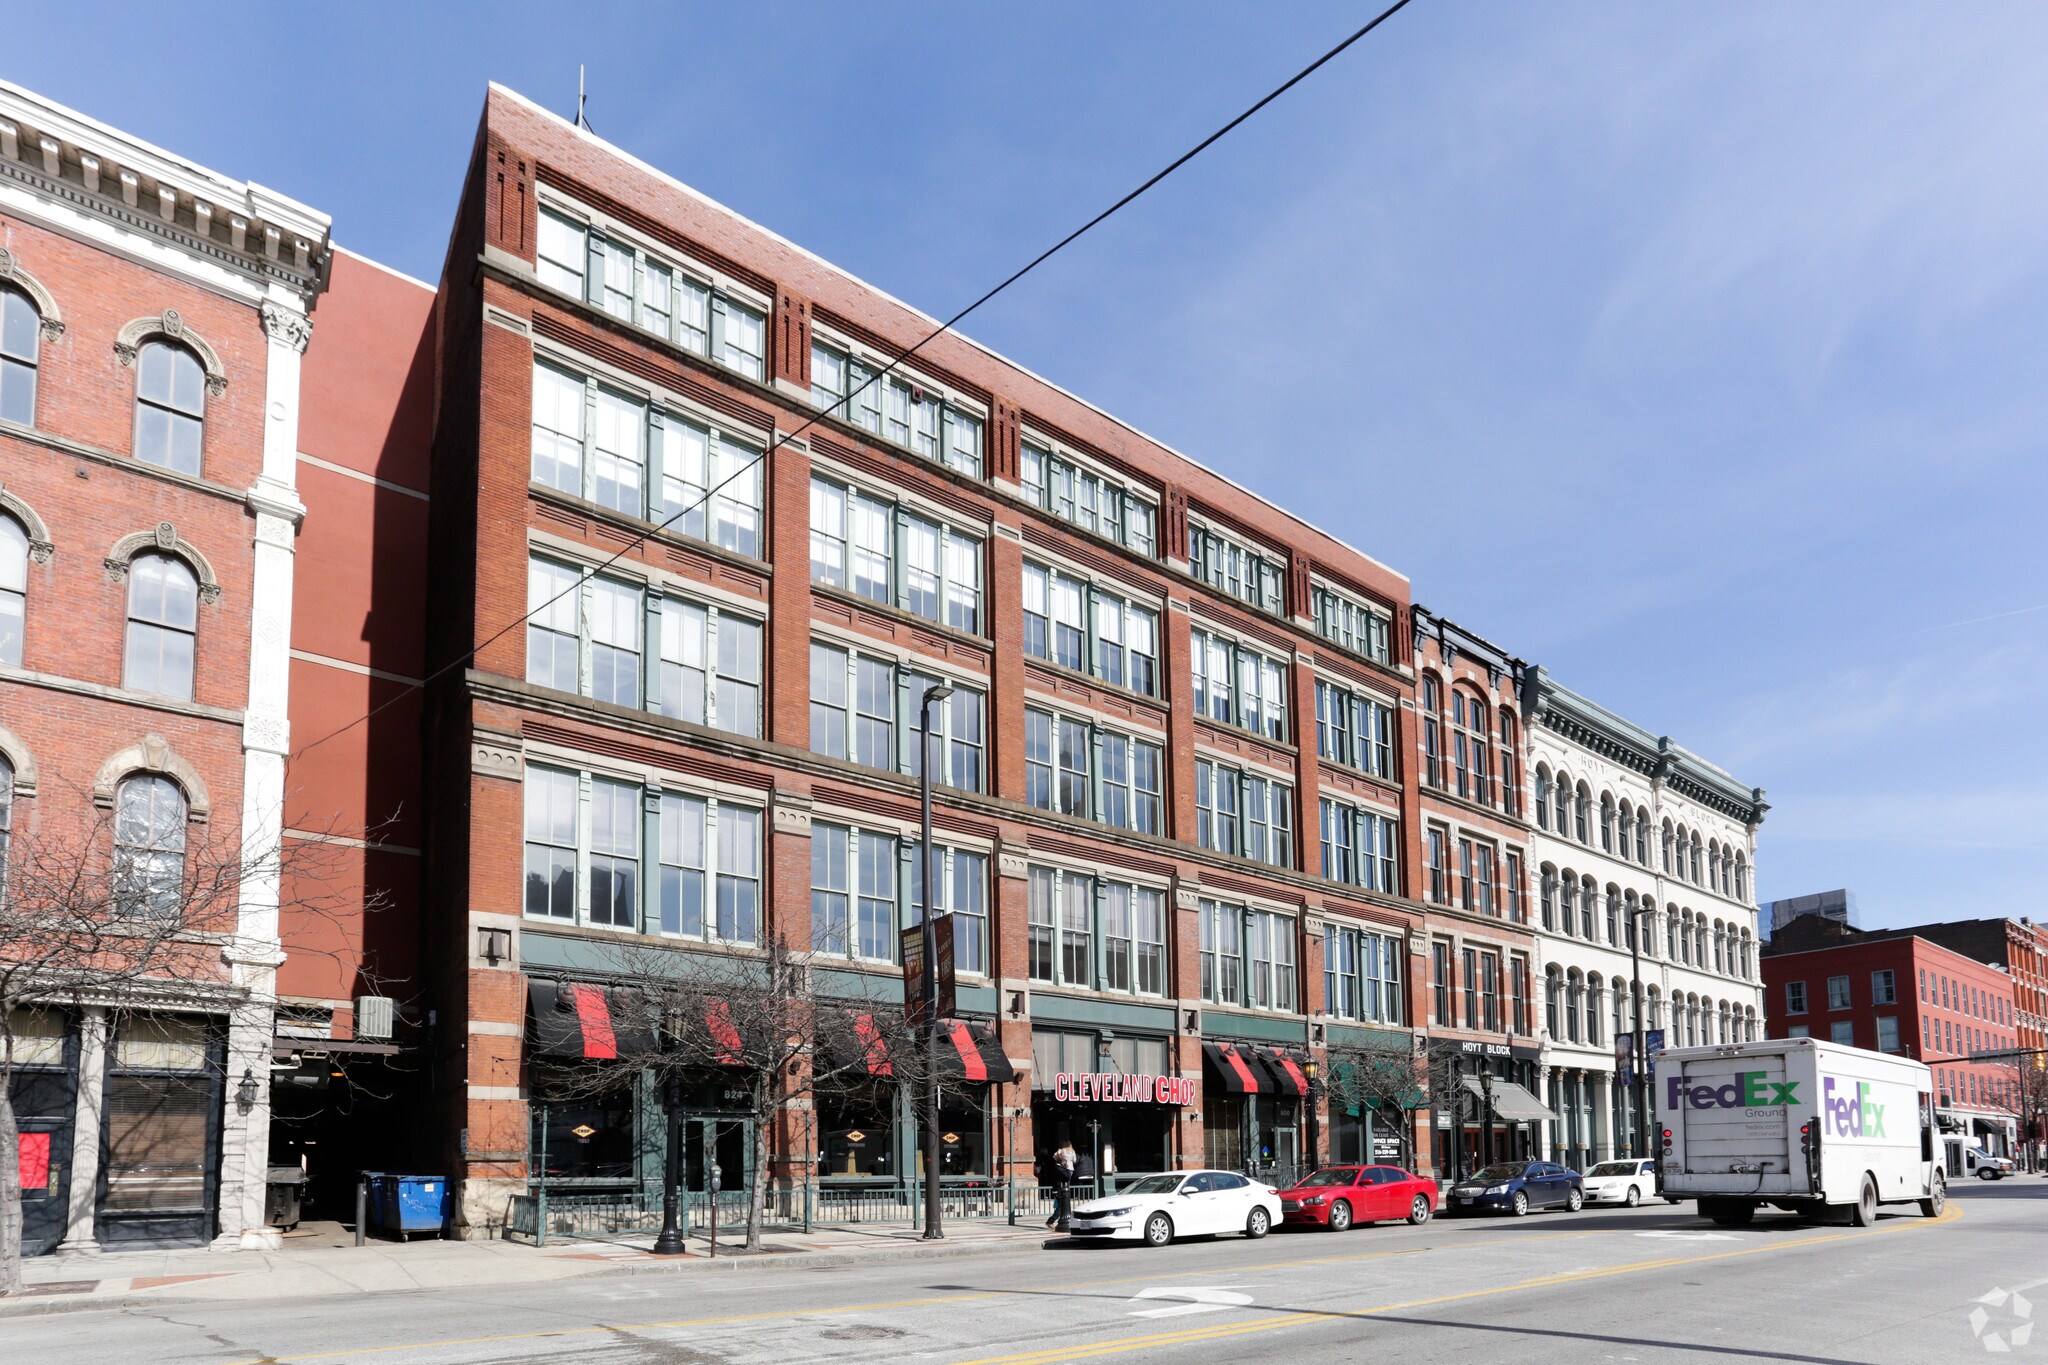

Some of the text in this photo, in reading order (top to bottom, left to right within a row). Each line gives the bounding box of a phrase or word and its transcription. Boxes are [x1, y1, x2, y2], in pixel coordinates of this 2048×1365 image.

[1462, 1042, 1511, 1055] HOYT BLOCK
[724, 1090, 743, 1099] 824
[1055, 1073, 1195, 1105] CLEVELAND CHOP
[1667, 1071, 1801, 1110] FedEx
[1745, 1107, 1786, 1117] Ground
[1823, 1077, 1887, 1138] FedEx
